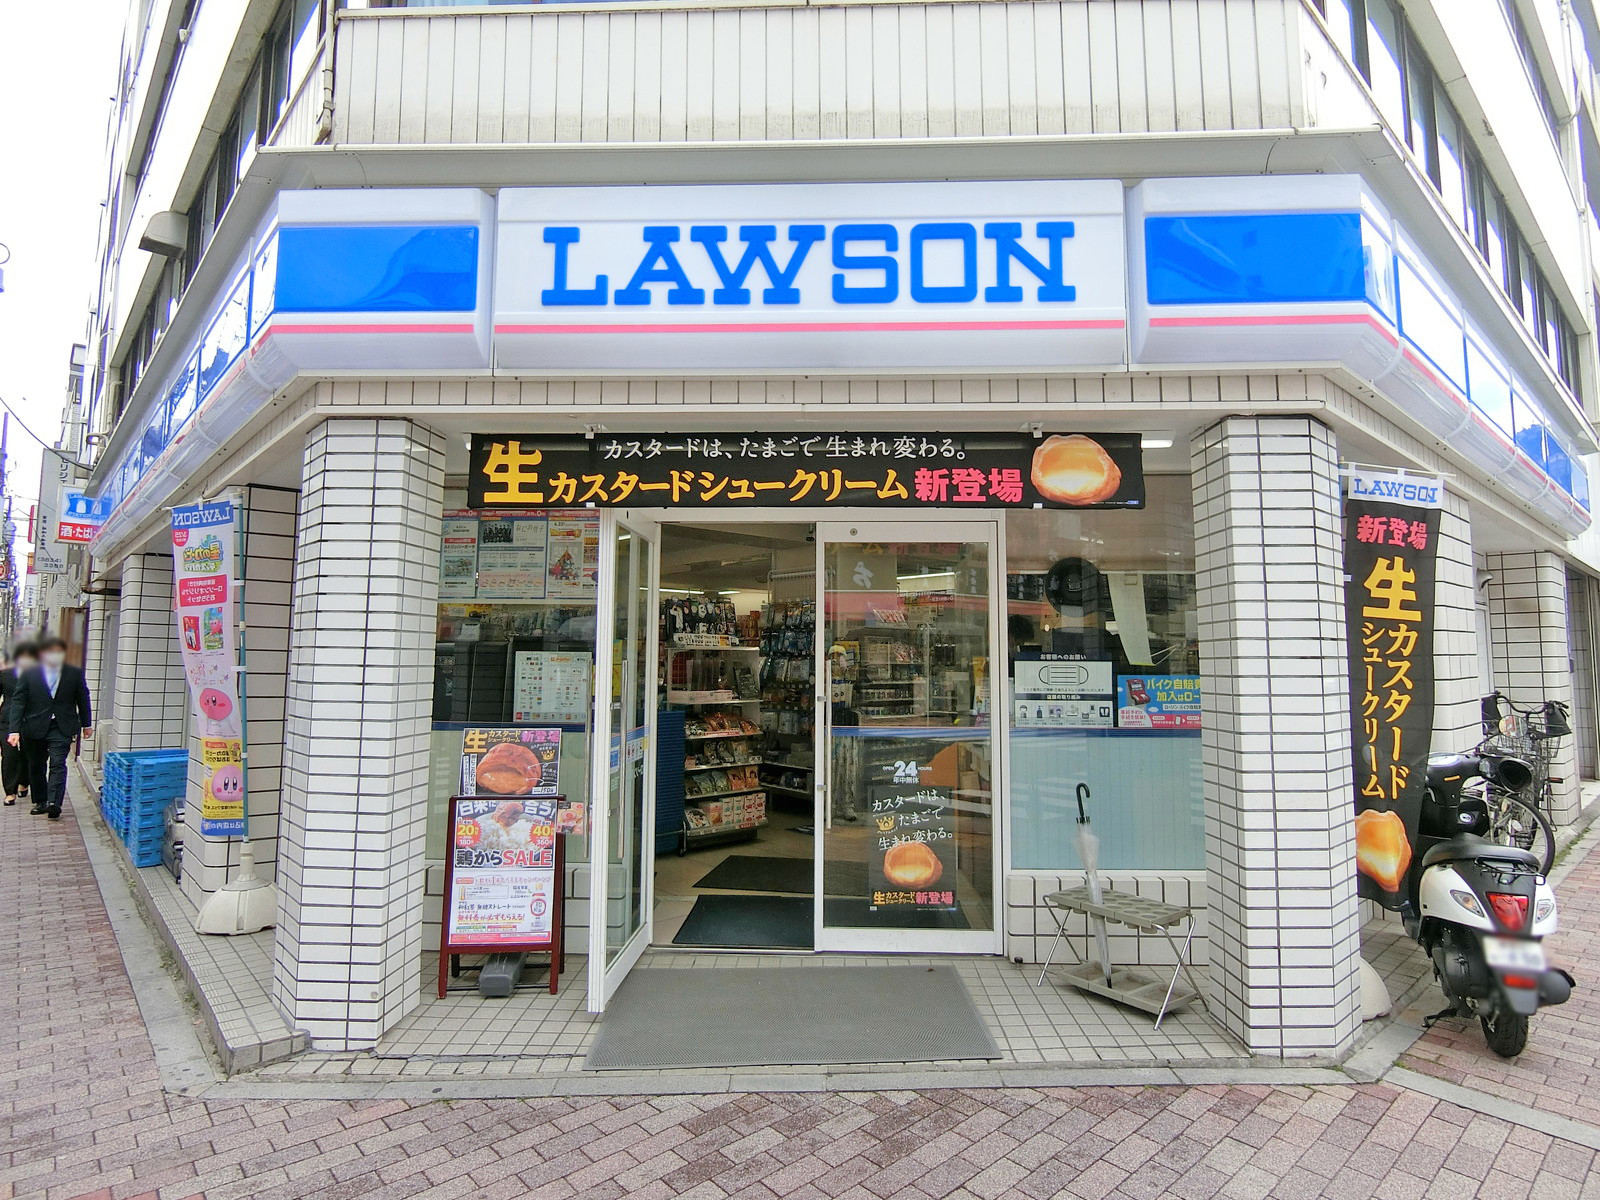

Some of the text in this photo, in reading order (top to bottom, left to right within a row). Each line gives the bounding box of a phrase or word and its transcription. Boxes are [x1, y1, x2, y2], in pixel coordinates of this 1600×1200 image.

[541, 221, 1077, 307] LAWSON
[914, 467, 1024, 503] 新登場
[1356, 514, 1428, 550] 新登場
[1362, 556, 1423, 622] 生
[1361, 621, 1387, 799] シュークリーム
[1382, 622, 1419, 800] カスタード
[463, 729, 488, 753] 生
[892, 776, 919, 784] 年中無休
[894, 760, 918, 776] 24
[872, 788, 946, 812] カスタードは、
[898, 805, 944, 826] たまごで
[879, 826, 953, 851] 生まれ変わる。
[873, 891, 885, 905] 生
[915, 891, 954, 905] 新登場
